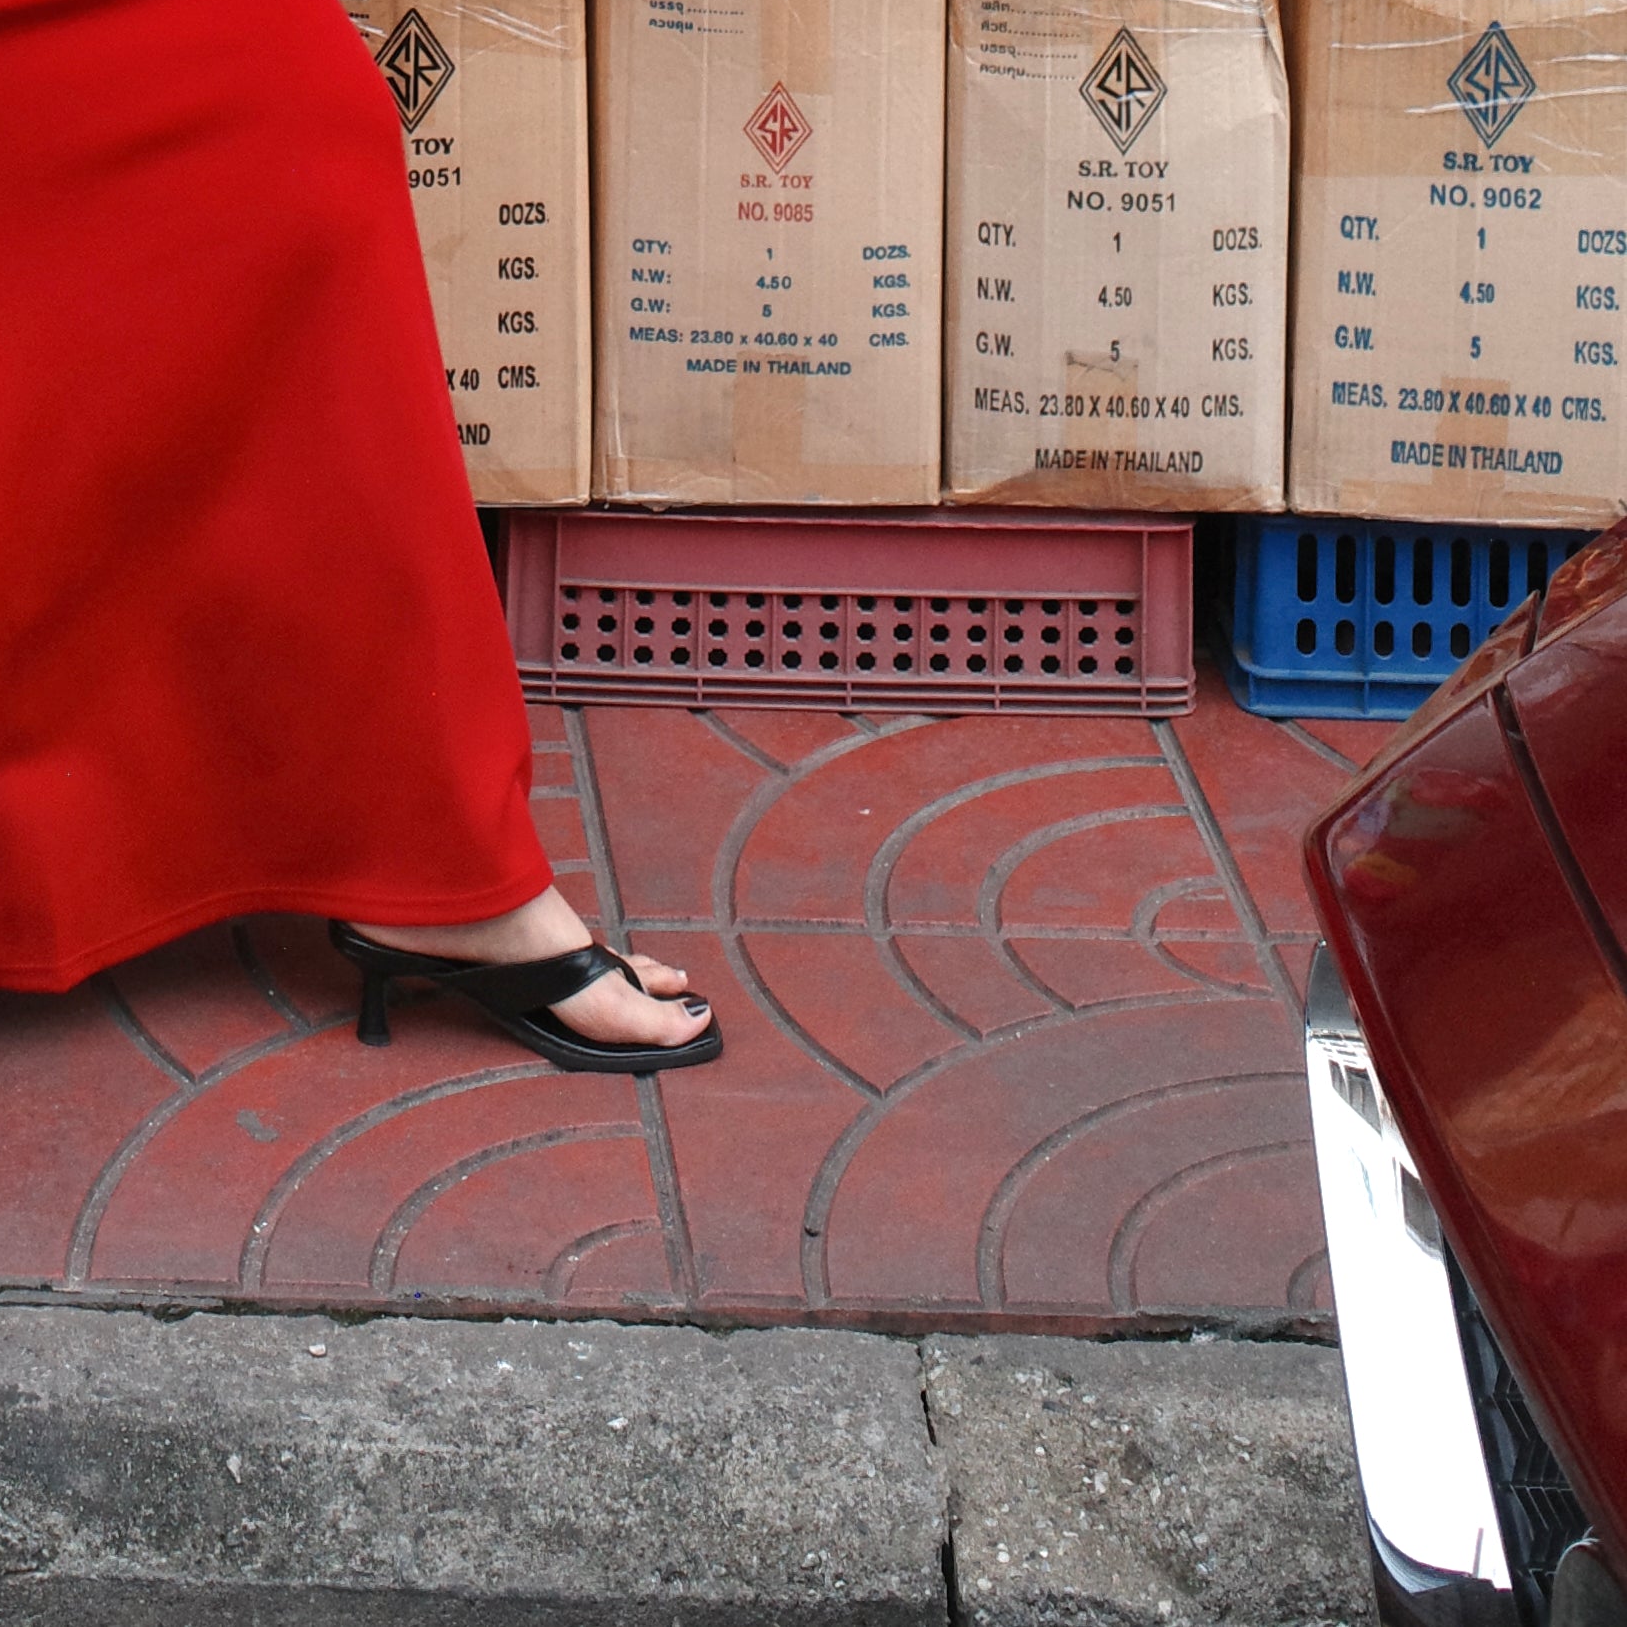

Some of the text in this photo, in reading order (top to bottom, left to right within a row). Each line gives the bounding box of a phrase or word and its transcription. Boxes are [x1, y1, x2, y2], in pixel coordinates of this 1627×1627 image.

[412, 138, 454, 155] TOY
[1079, 161, 1168, 178] S.R. TOY
[1443, 151, 1533, 173] S.R. TOY
[741, 174, 813, 189] S.R. TOY
[1068, 191, 1174, 212] NO. 9051
[1431, 184, 1541, 209] NO. 9062
[739, 202, 813, 222] NO. 9085
[687, 359, 851, 375] MADE IN THAILAND
[1035, 449, 1203, 475] MADE IN THAILAND
[1391, 441, 1562, 474] MADE IN THAILAND
